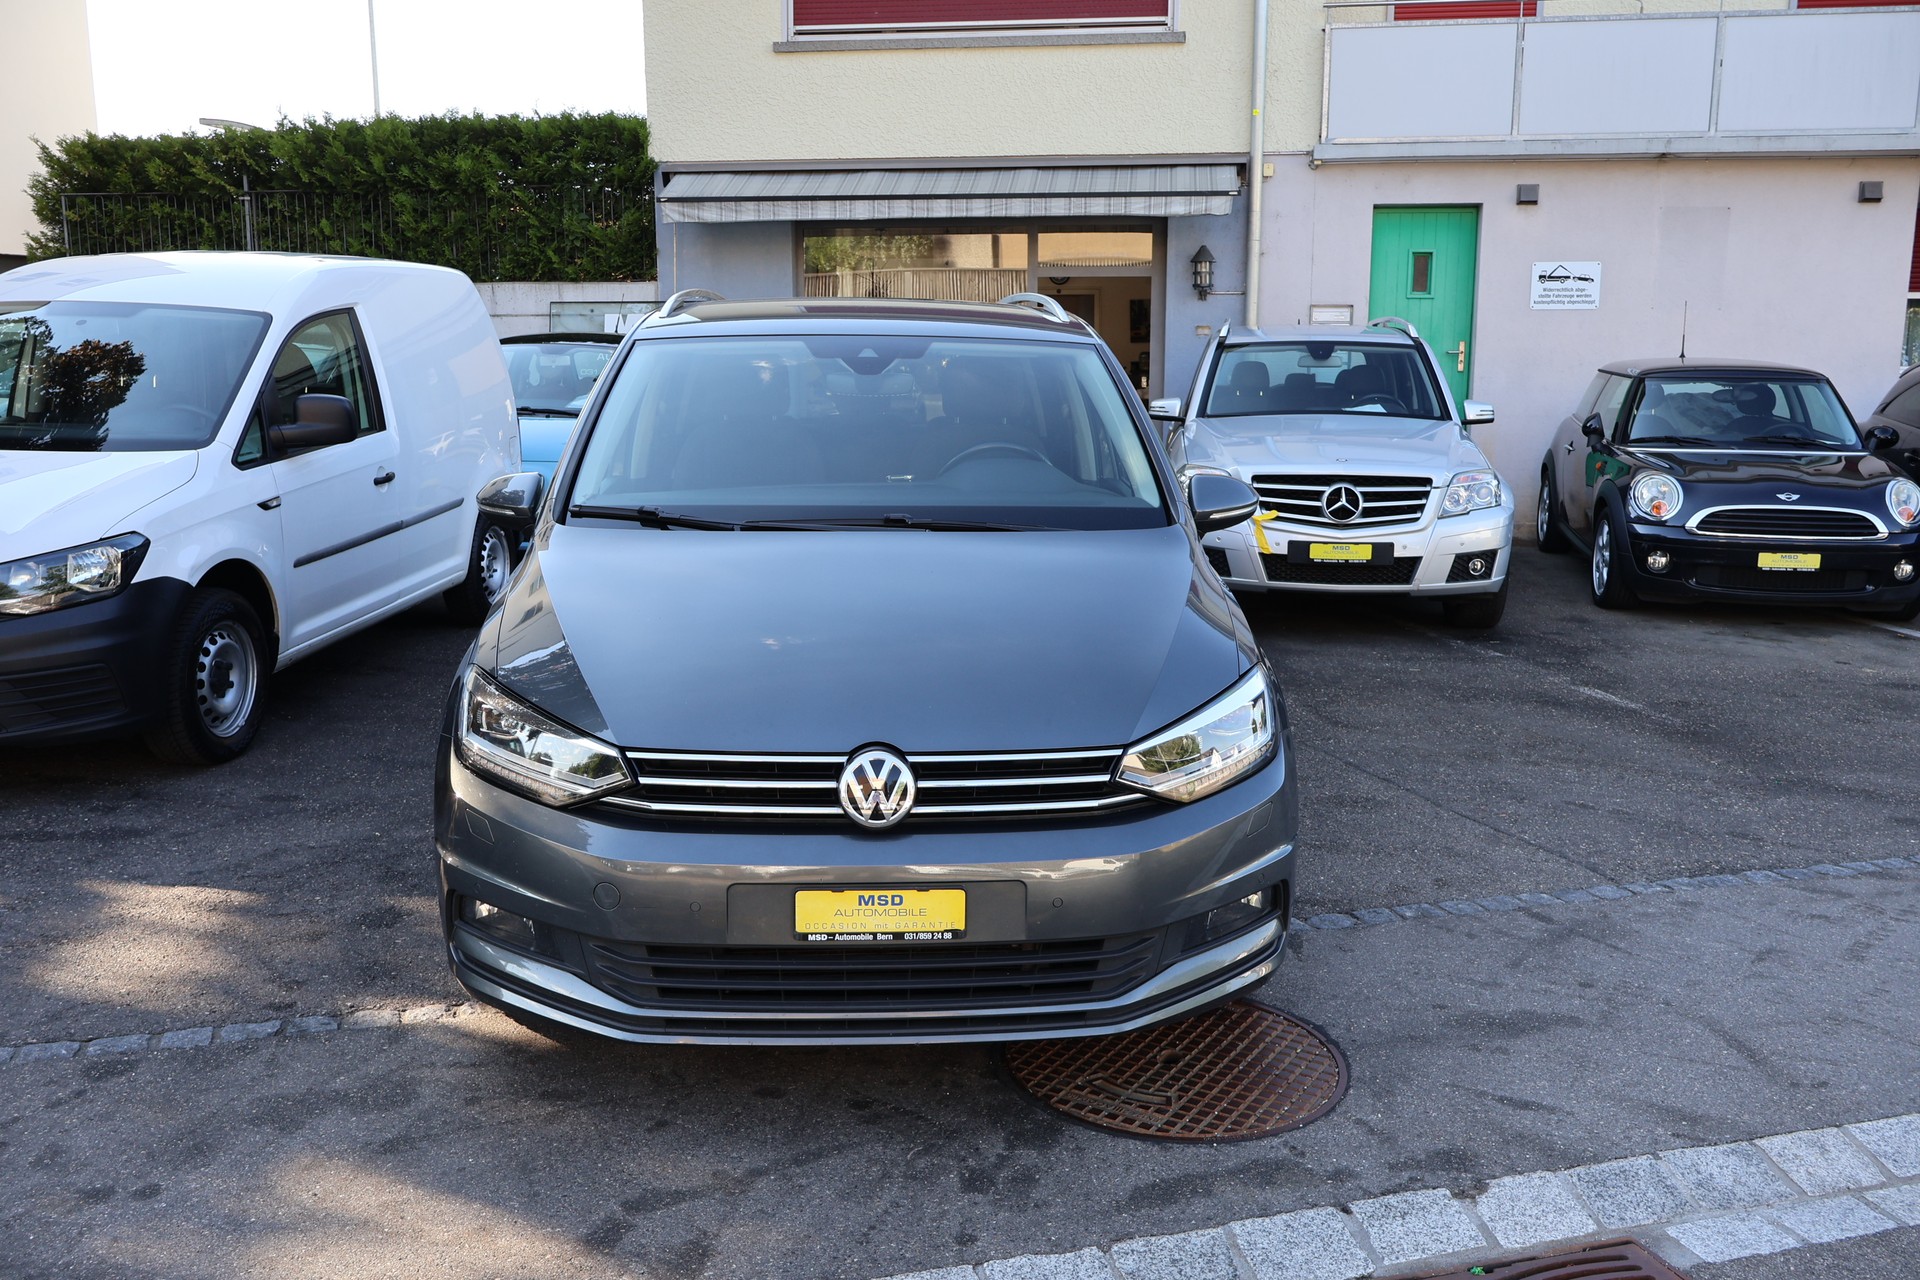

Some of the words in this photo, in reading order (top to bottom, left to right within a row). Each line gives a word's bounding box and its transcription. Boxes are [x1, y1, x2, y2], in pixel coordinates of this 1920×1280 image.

[857, 894, 904, 907] MSD
[833, 908, 928, 918] AUTOMOBILE
[804, 922, 867, 930] OCCASION
[894, 921, 957, 929] GARANTIE
[876, 933, 893, 941] Bern
[904, 932, 932, 940] 031/859
[932, 932, 942, 940] 24
